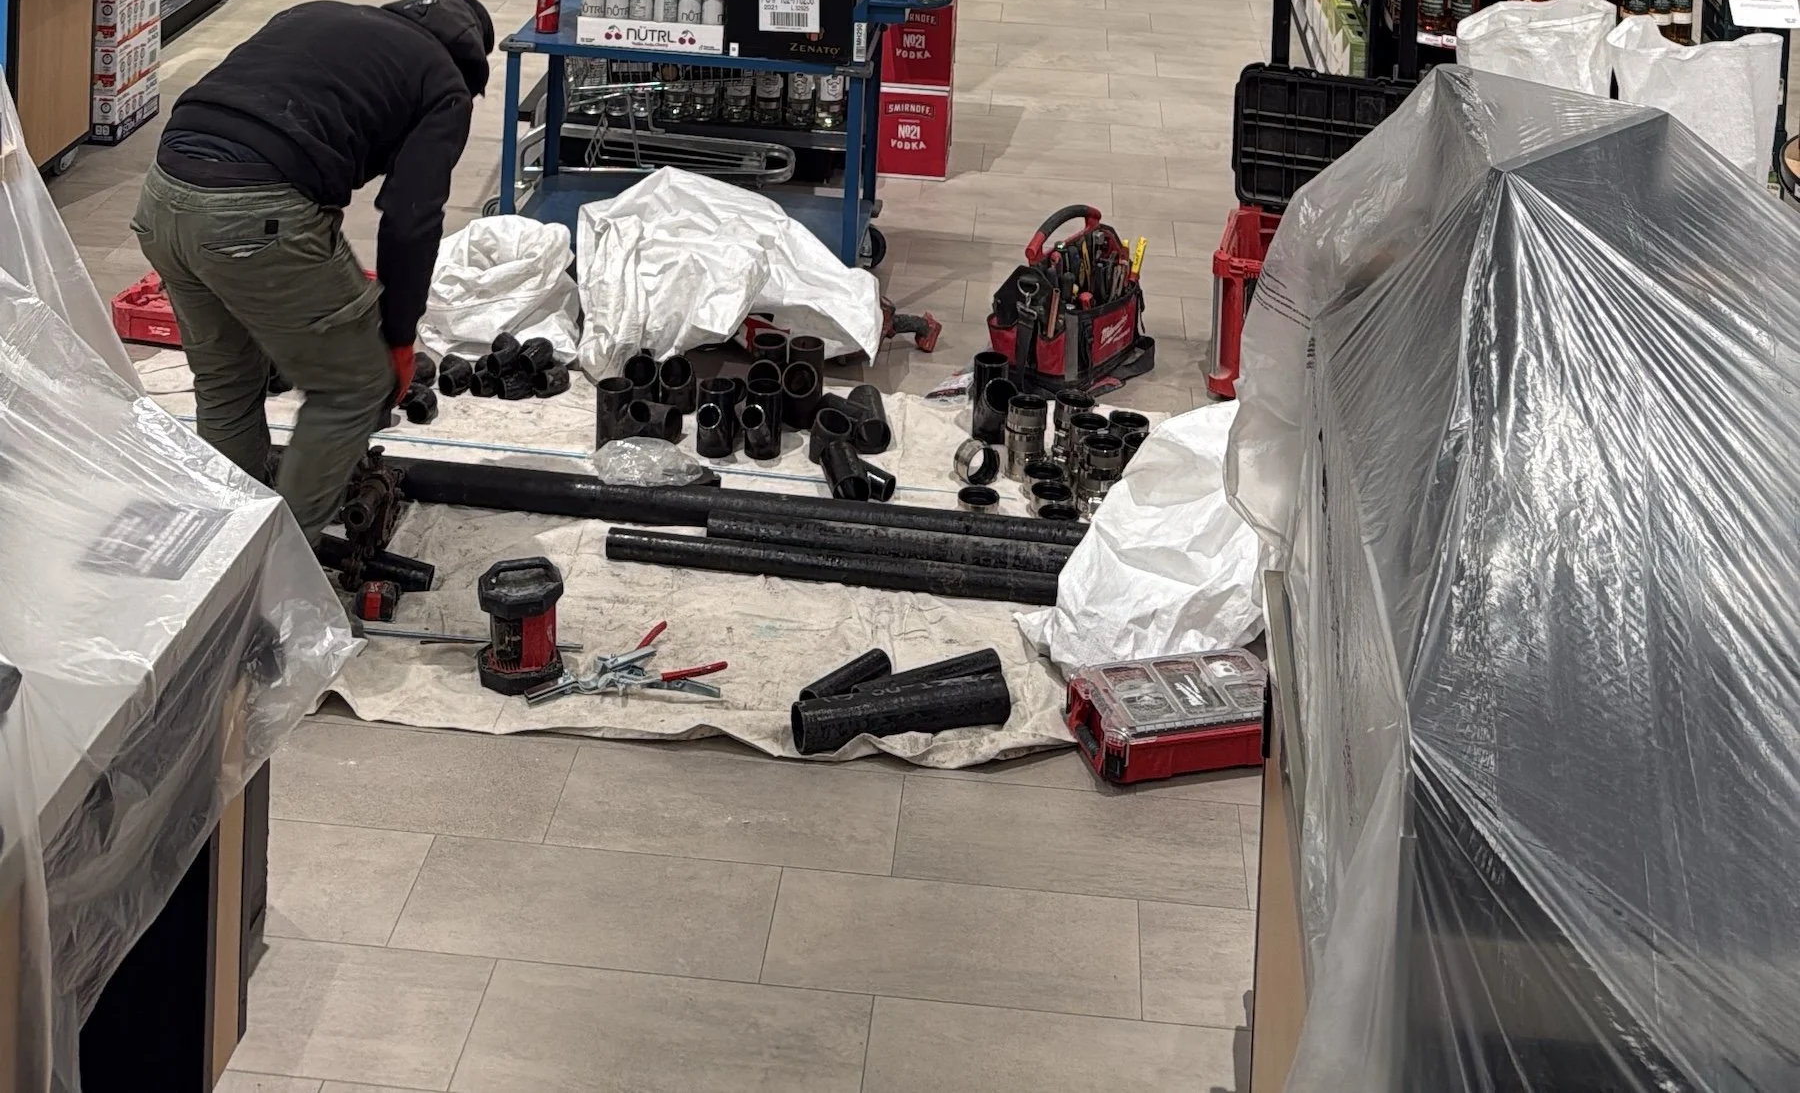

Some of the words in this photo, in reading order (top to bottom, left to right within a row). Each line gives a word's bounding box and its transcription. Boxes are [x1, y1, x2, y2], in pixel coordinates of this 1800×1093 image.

[789, 42, 840, 56] ZENATO
[895, 48, 932, 59] VODKA
[890, 138, 928, 150] VODKA
